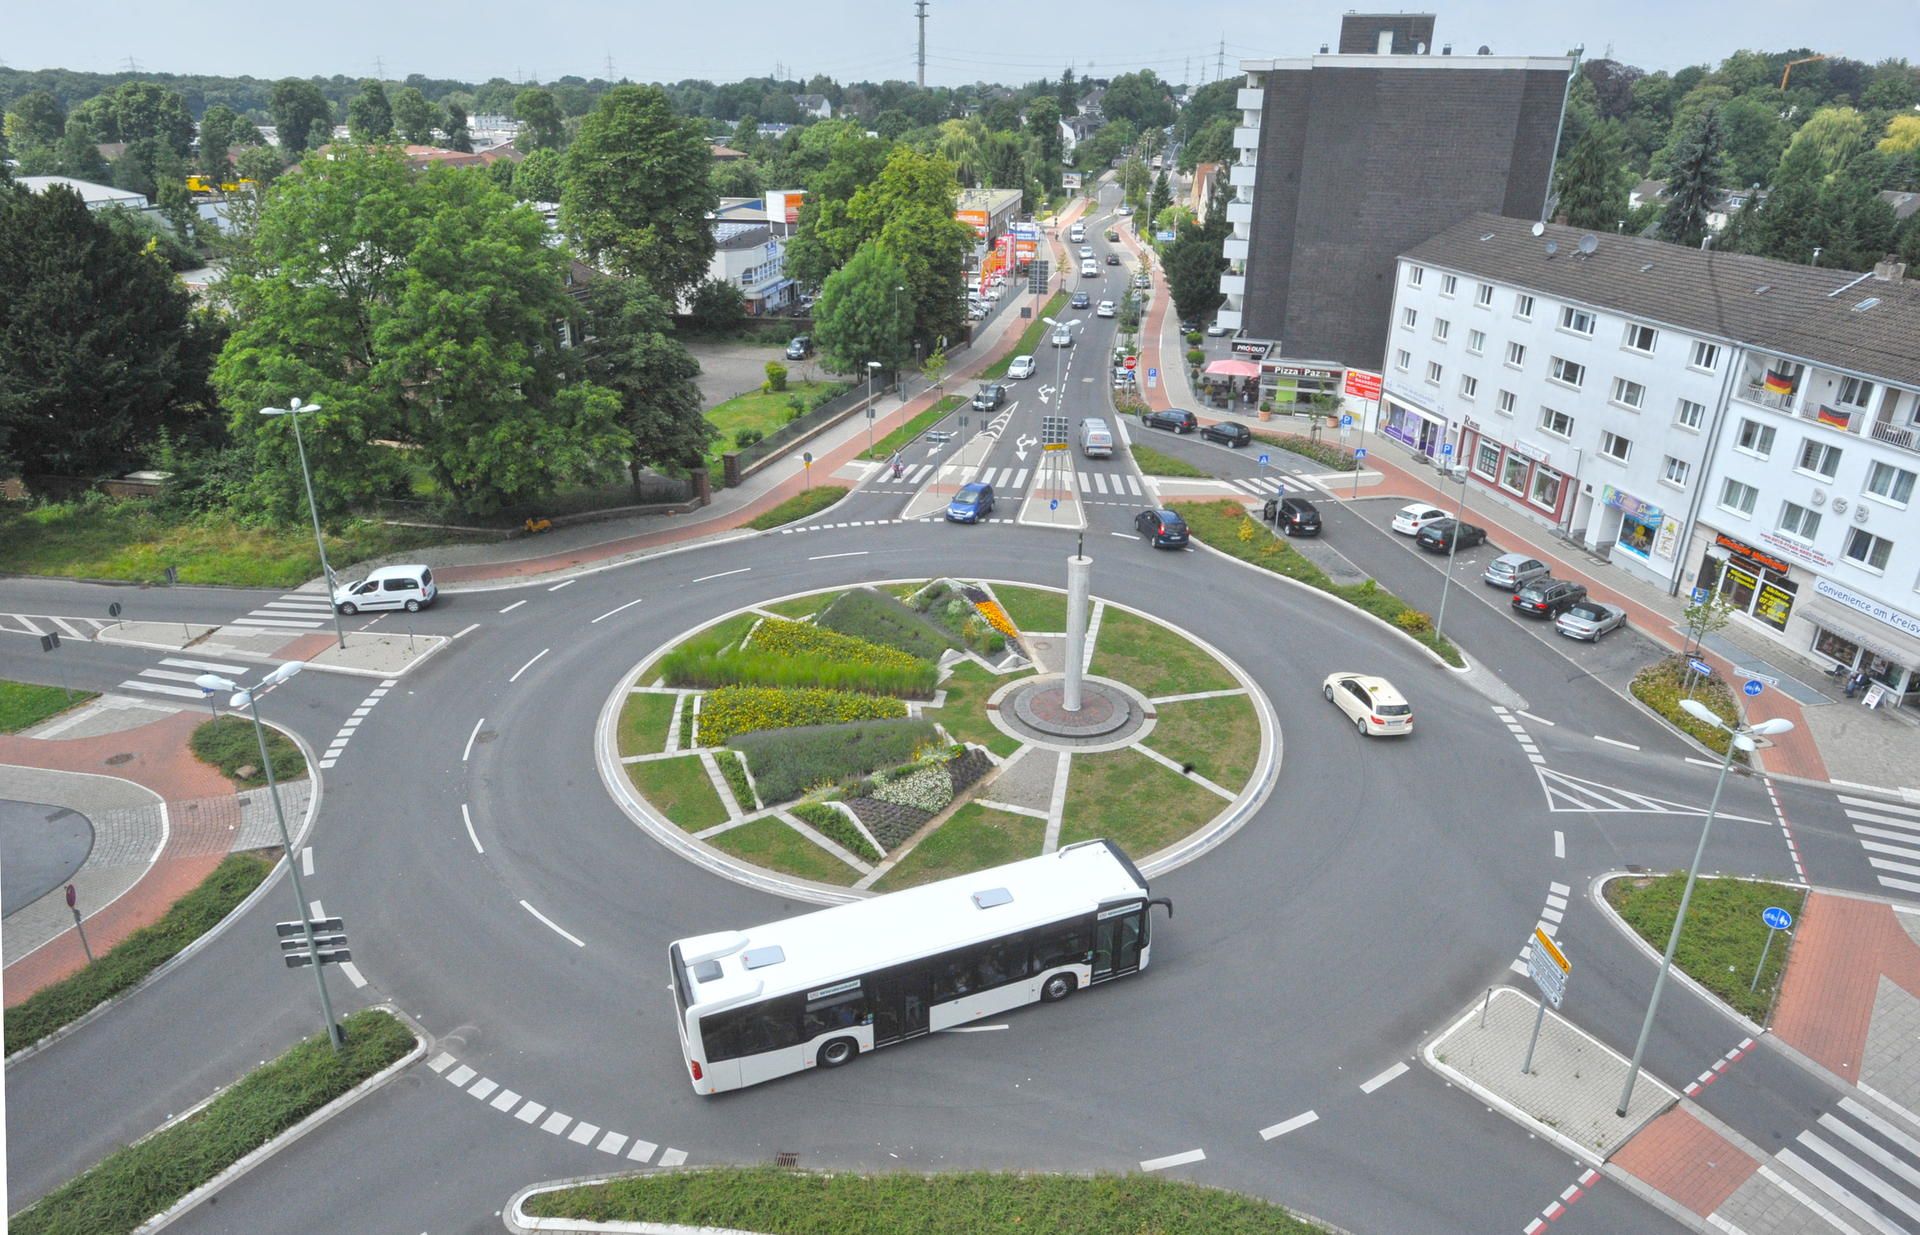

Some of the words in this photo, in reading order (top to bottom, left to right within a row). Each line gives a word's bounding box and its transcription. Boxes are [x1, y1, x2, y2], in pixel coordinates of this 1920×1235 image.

[1237, 344, 1250, 352] PRO
[1251, 345, 1265, 353] DUO
[1274, 366, 1299, 375] Pizza
[1304, 368, 1331, 378] Paza
[1817, 581, 1871, 612] Convenience
[1873, 607, 1888, 619] am
